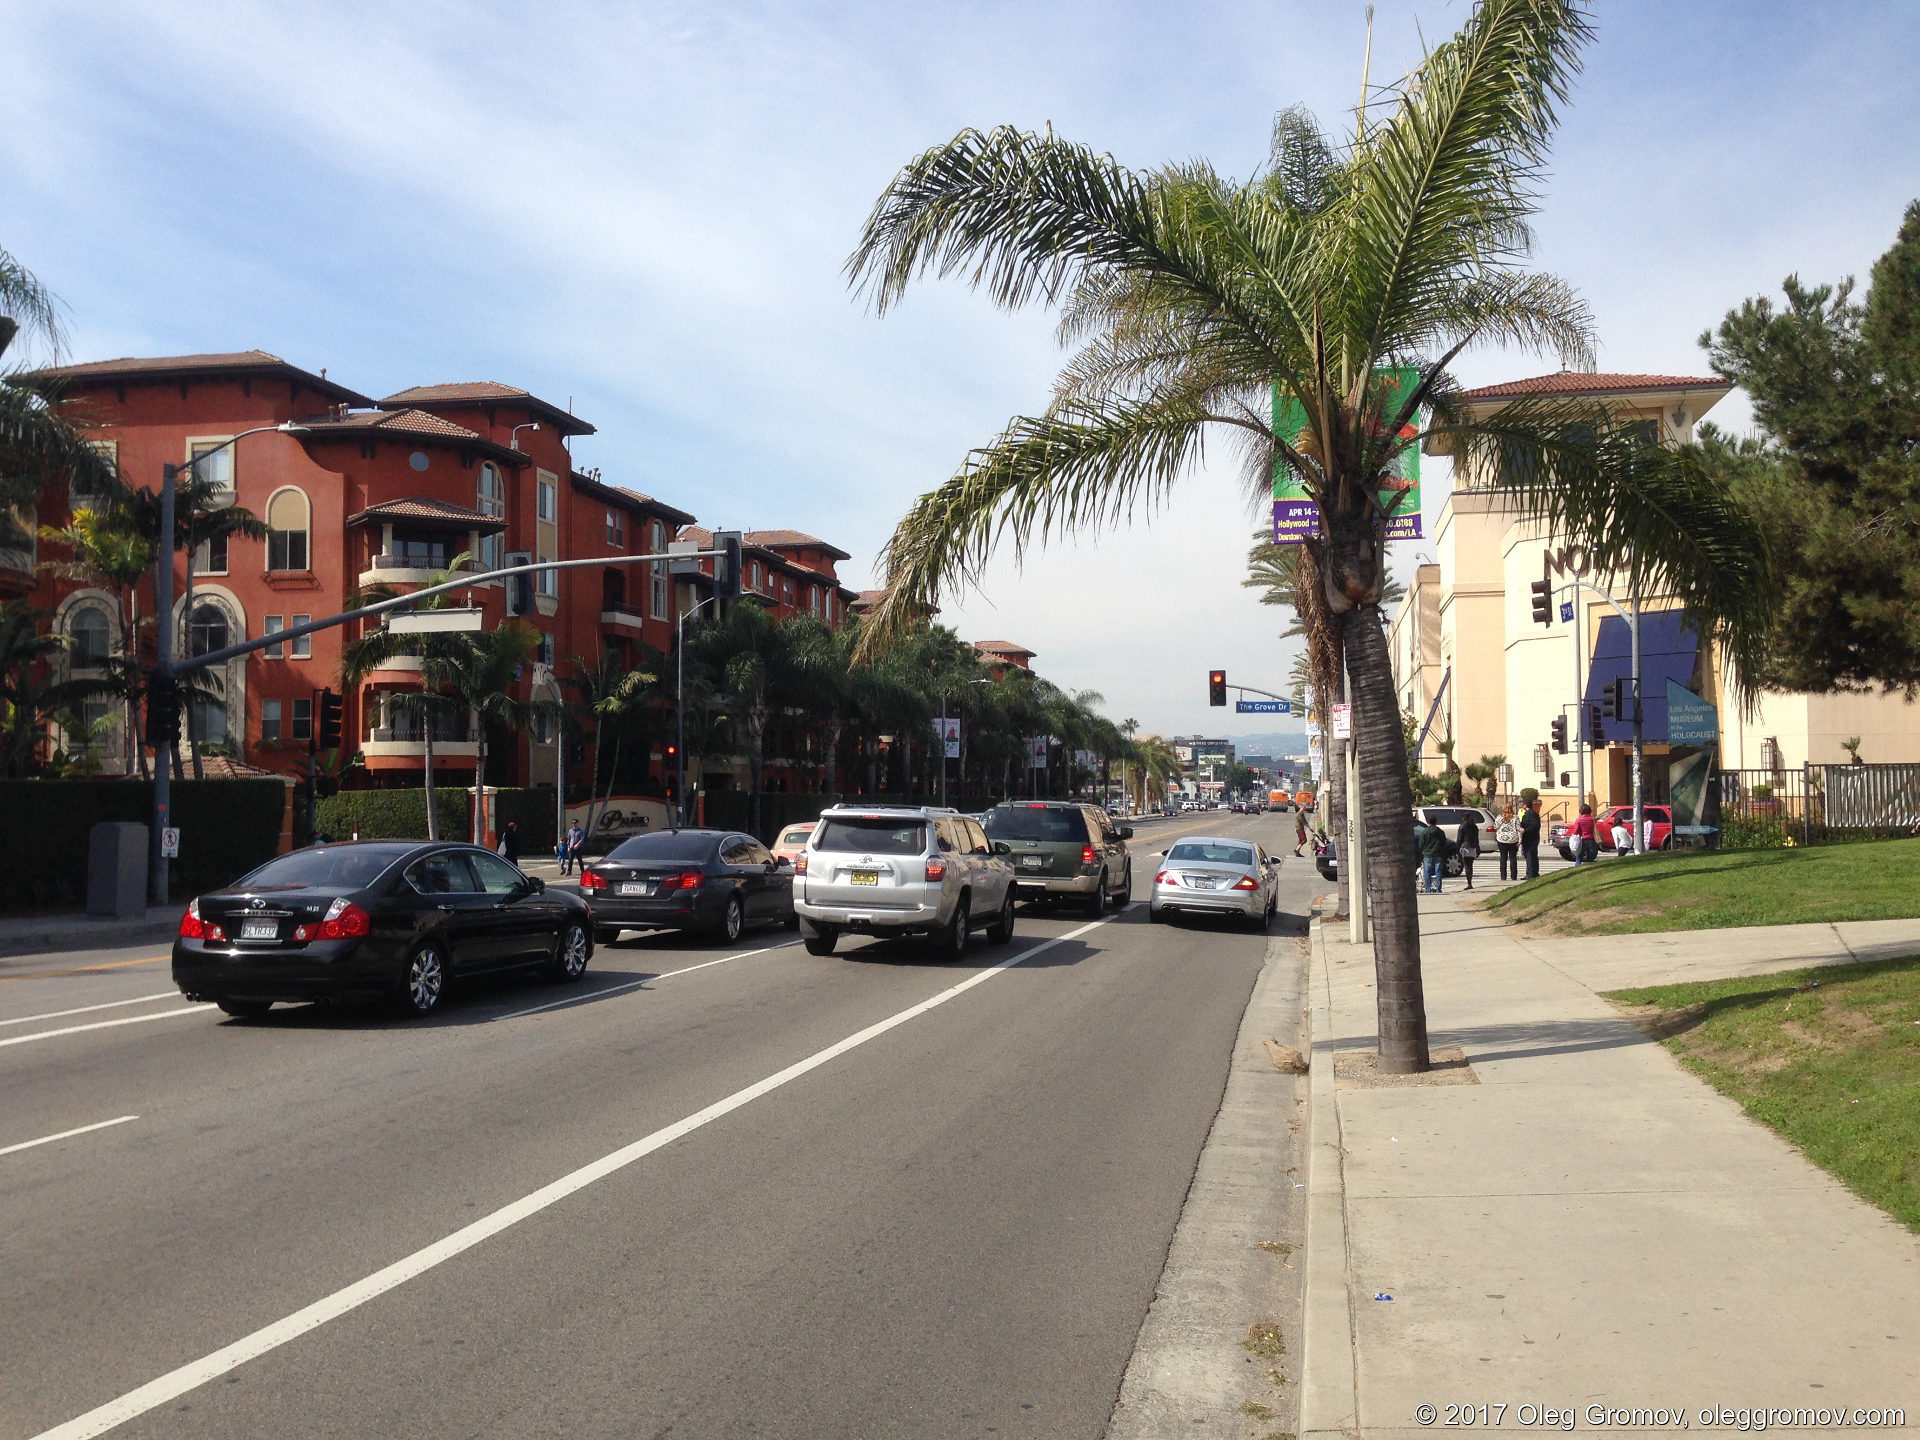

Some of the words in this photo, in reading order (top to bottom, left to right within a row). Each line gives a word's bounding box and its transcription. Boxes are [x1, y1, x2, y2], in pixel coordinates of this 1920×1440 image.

[1289, 508, 1302, 517] APR
[1278, 519, 1309, 529] Hollywood
[1240, 703, 1253, 711] The
[1254, 703, 1276, 711] Grove
[1278, 703, 1288, 711] Dr
[1669, 705, 1683, 713] Los
[1684, 704, 1714, 714] Angeles
[1670, 714, 1704, 723] MUSEUM
[1671, 730, 1716, 740] HOLOCAUST
